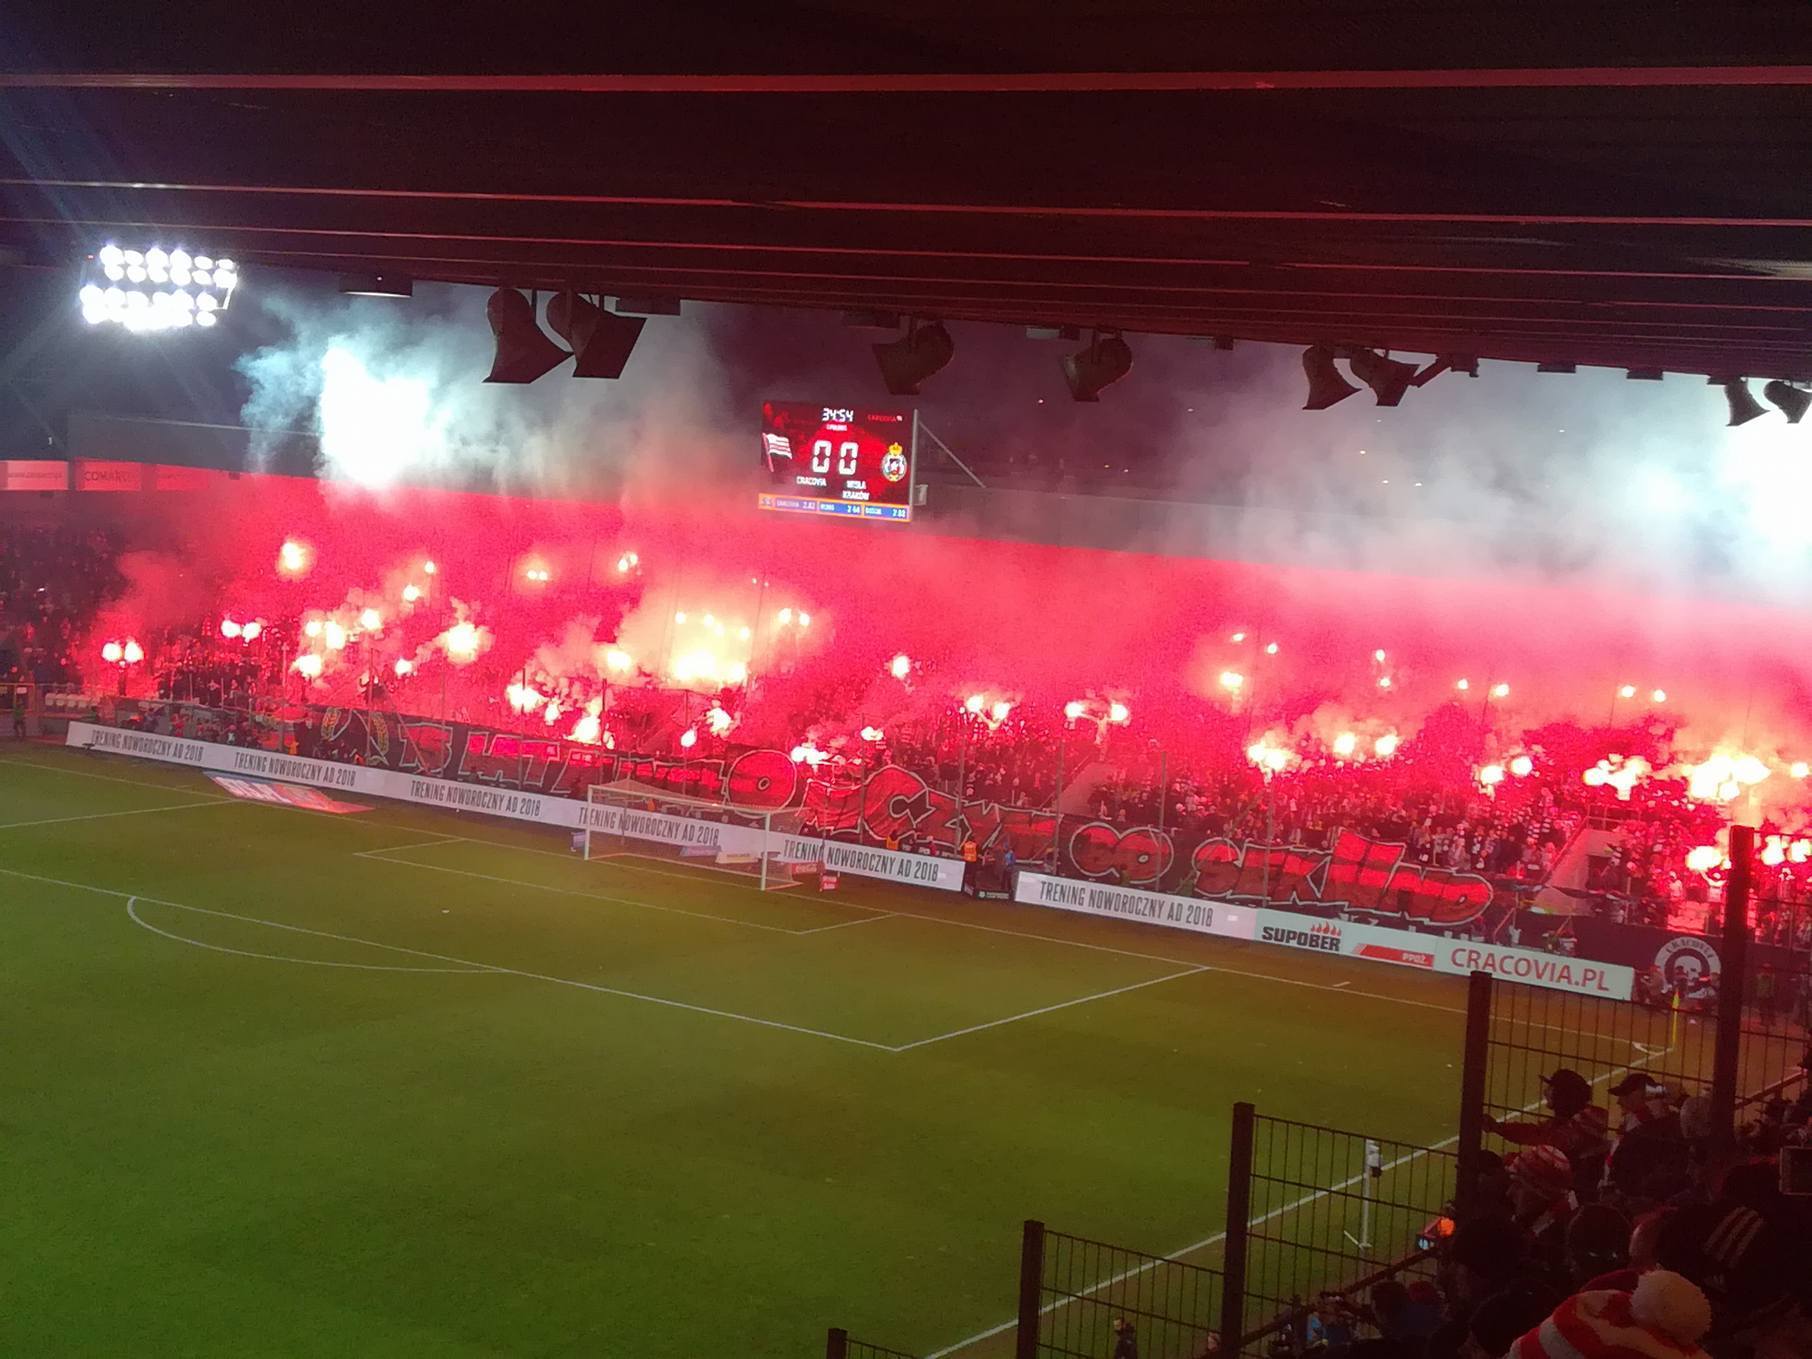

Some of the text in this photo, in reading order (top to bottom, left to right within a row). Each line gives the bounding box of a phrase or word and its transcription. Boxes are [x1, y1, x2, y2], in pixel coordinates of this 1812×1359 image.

[812, 439, 859, 475] 0 0
[91, 730, 204, 762] TRENING NOWOROCZNY AD 2018
[234, 751, 356, 787] TRENING NOWOROCZNY AD 2018
[410, 780, 541, 816] TRENING NOWOROCZNY AD 2018
[619, 813, 681, 839] NOWOROCZNY
[681, 828, 695, 843] AD
[696, 826, 720, 847] 2018
[827, 846, 895, 873] NOWOROCZNY
[896, 859, 911, 877] AD
[914, 860, 939, 882] 2018
[1039, 880, 1214, 928] TRENING NOWOROCZNY AD 2018
[1261, 925, 1341, 951] SUPOBER
[1450, 948, 1609, 991] CRACOVIA.PL
